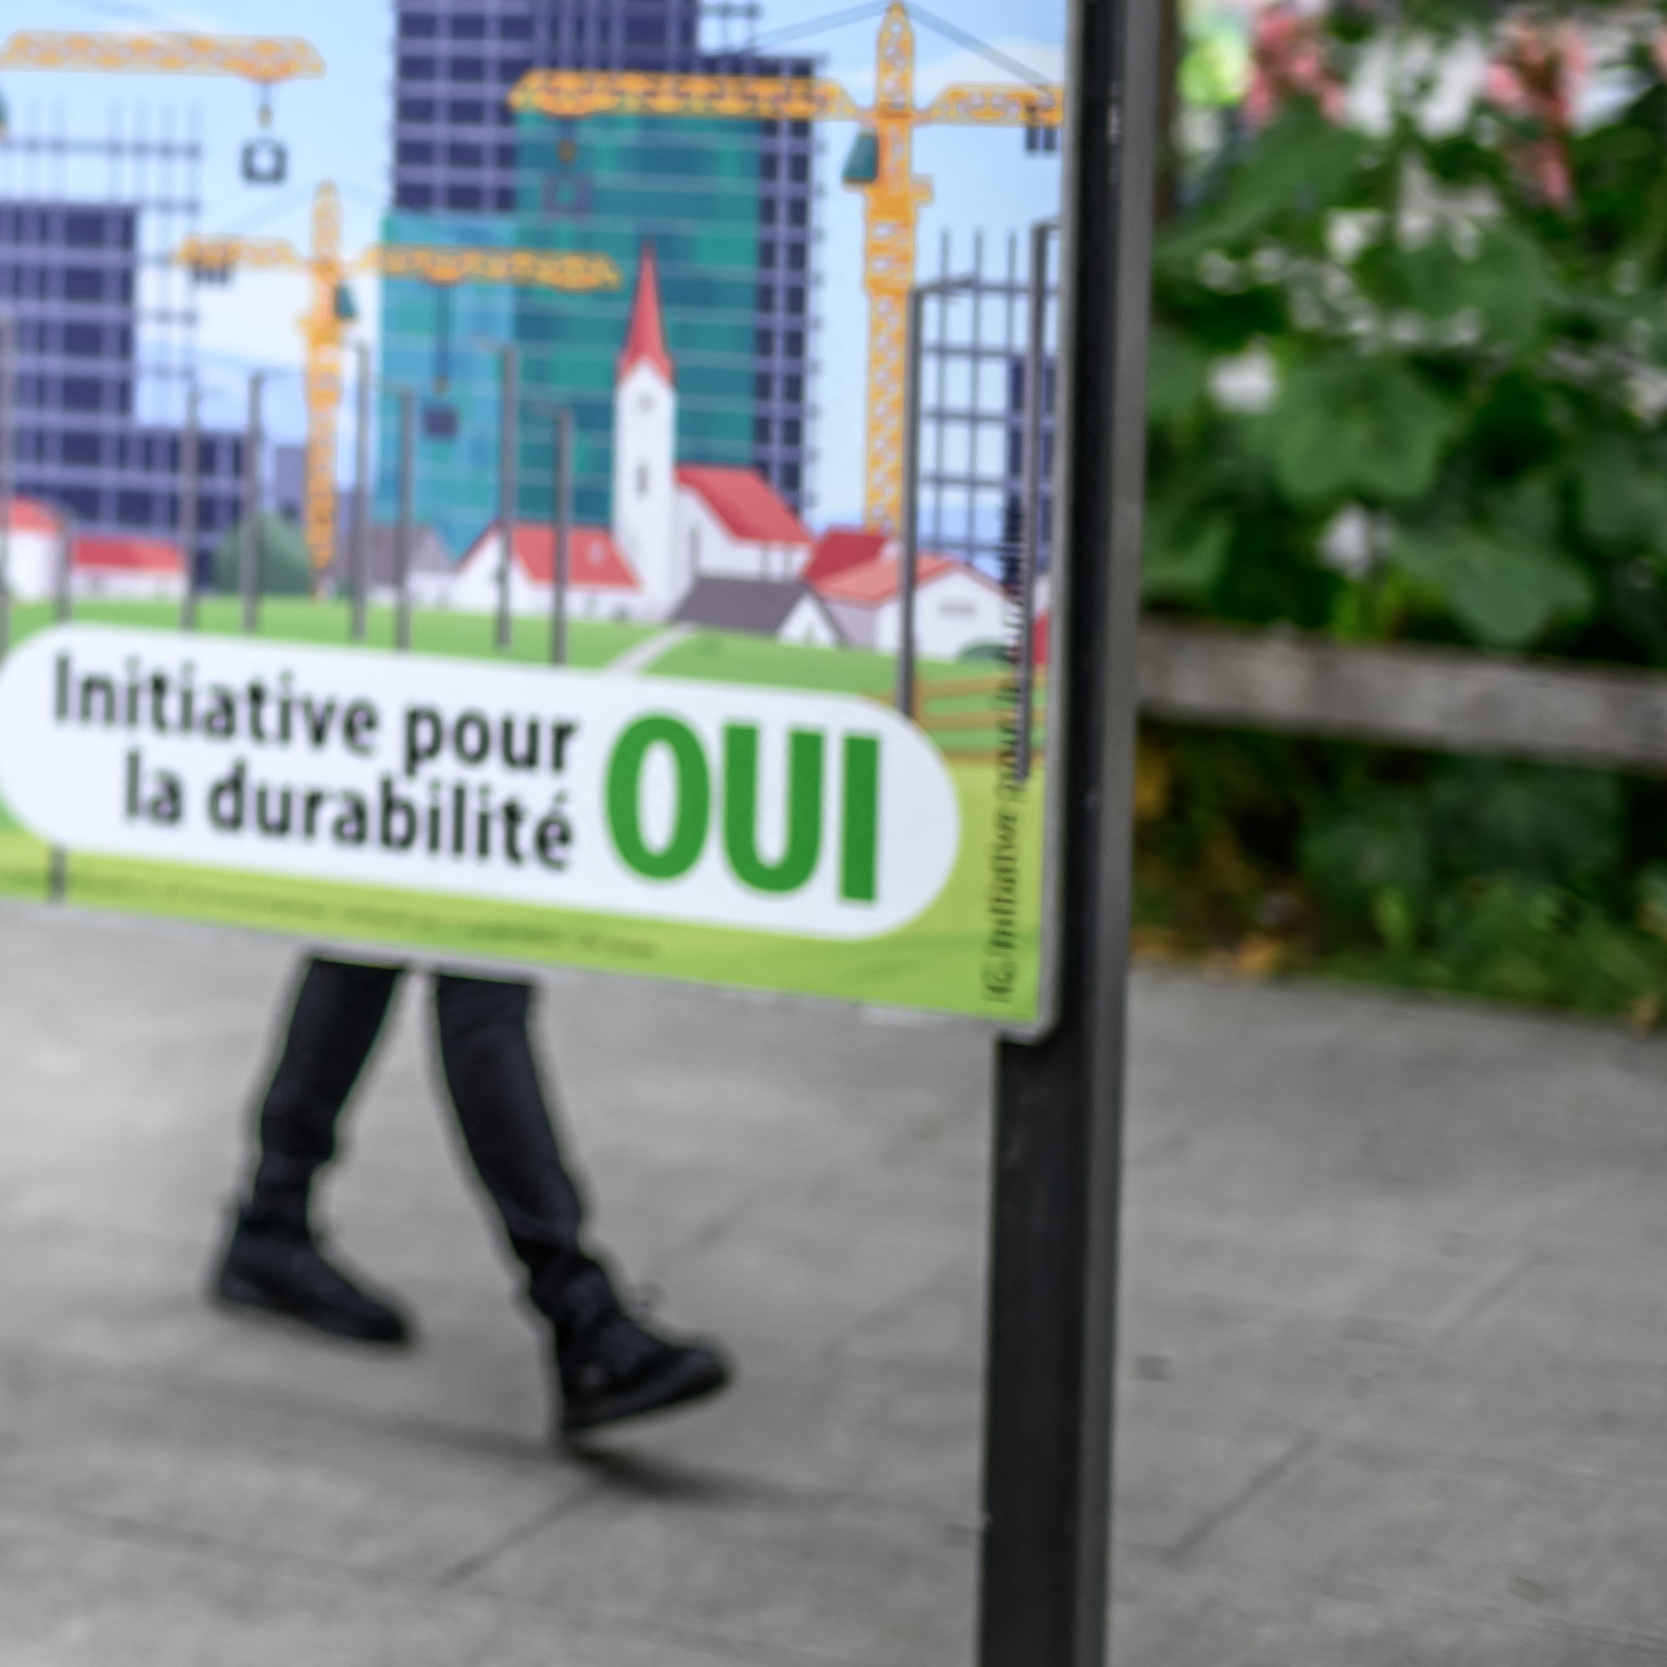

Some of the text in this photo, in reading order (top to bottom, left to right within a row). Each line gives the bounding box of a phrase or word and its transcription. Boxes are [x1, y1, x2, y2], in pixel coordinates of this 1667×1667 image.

[54, 650, 579, 778] Initiative pour
[126, 746, 573, 871] la durabilité
[605, 712, 883, 905] OUI
